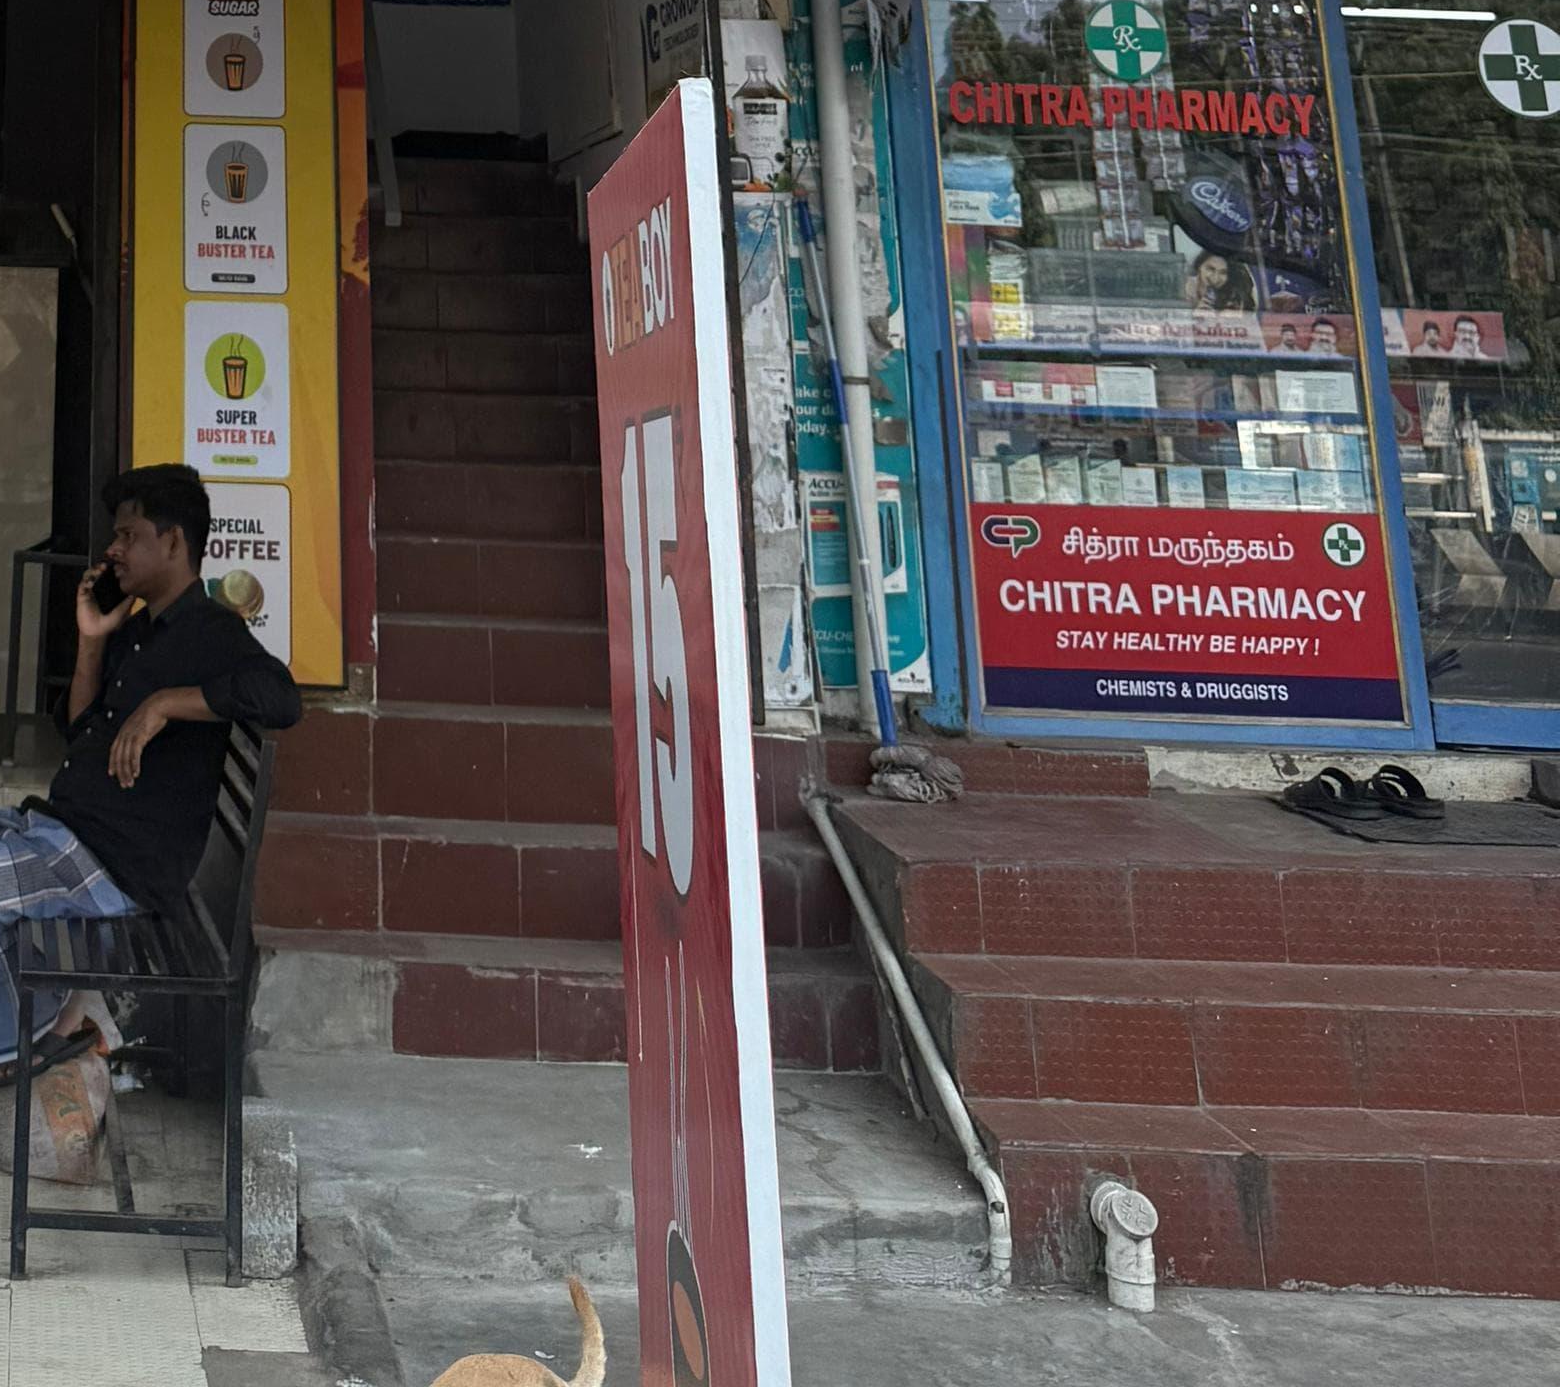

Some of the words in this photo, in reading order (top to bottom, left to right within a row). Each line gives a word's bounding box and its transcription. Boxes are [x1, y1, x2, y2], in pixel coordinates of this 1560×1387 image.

[209, 1, 259, 16] SUGAR
[949, 80, 1093, 127] CHITRA
[1103, 86, 1316, 138] PHARMACY
[215, 226, 256, 241] BLACK
[198, 244, 246, 259] BUSTER
[251, 245, 275, 260] TEA
[216, 410, 257, 425] SUPER
[197, 429, 247, 445] BUSTER
[251, 430, 276, 446] TEA
[210, 519, 264, 534] SPECIAL
[1062, 526, 1140, 565] சித்ரா
[1147, 532, 1293, 570] மருந்தகம்
[1000, 579, 1140, 616] CHITRA
[1153, 584, 1367, 623] PHARMACY
[1056, 630, 1107, 651] STAY
[1113, 632, 1203, 653] HEALTHY
[1210, 634, 1235, 654] BE
[1242, 636, 1307, 658] HAPPY
[1096, 680, 1176, 698] CHEMISTS
[1196, 681, 1289, 702] DRUGGISTS
